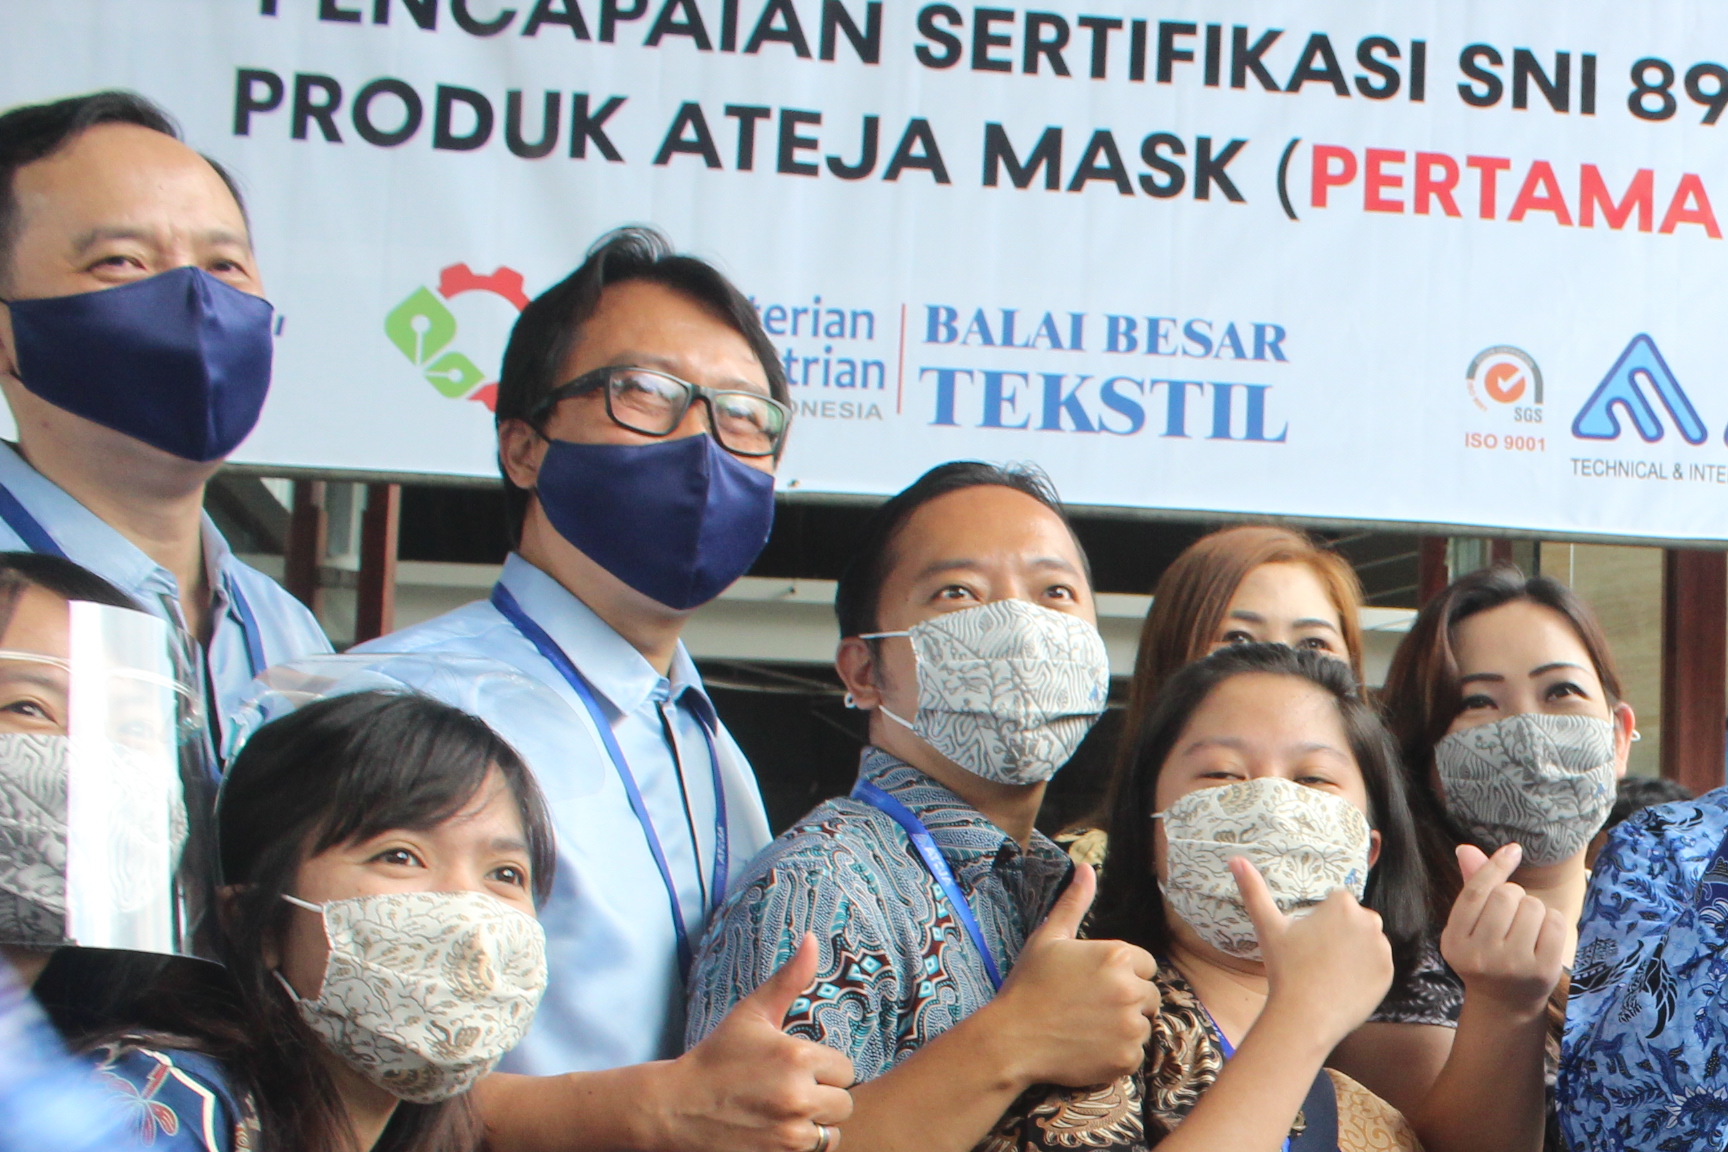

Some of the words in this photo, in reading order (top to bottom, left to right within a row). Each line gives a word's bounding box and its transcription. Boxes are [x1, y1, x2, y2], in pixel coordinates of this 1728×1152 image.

[257, 0, 882, 65] CAPAIAN
[913, 2, 1427, 103] SERTIFIKASI
[1456, 41, 1598, 117] SNI
[232, 66, 629, 164] PRODUK
[652, 100, 952, 186] ATEJA
[981, 120, 1249, 204] MASK
[1276, 136, 1724, 240] (PERTAMA
[749, 294, 875, 341] erian
[923, 303, 1088, 352] BALAI
[1101, 312, 1290, 363] BESAR
[782, 343, 886, 390] trian
[918, 365, 1290, 443] TEKSTIL
[1513, 406, 1544, 424] SGS
[1464, 432, 1499, 450] ISO
[1503, 435, 1547, 452] 9001
[1569, 457, 1669, 481] TECHNICAL
[1672, 462, 1685, 482] &
